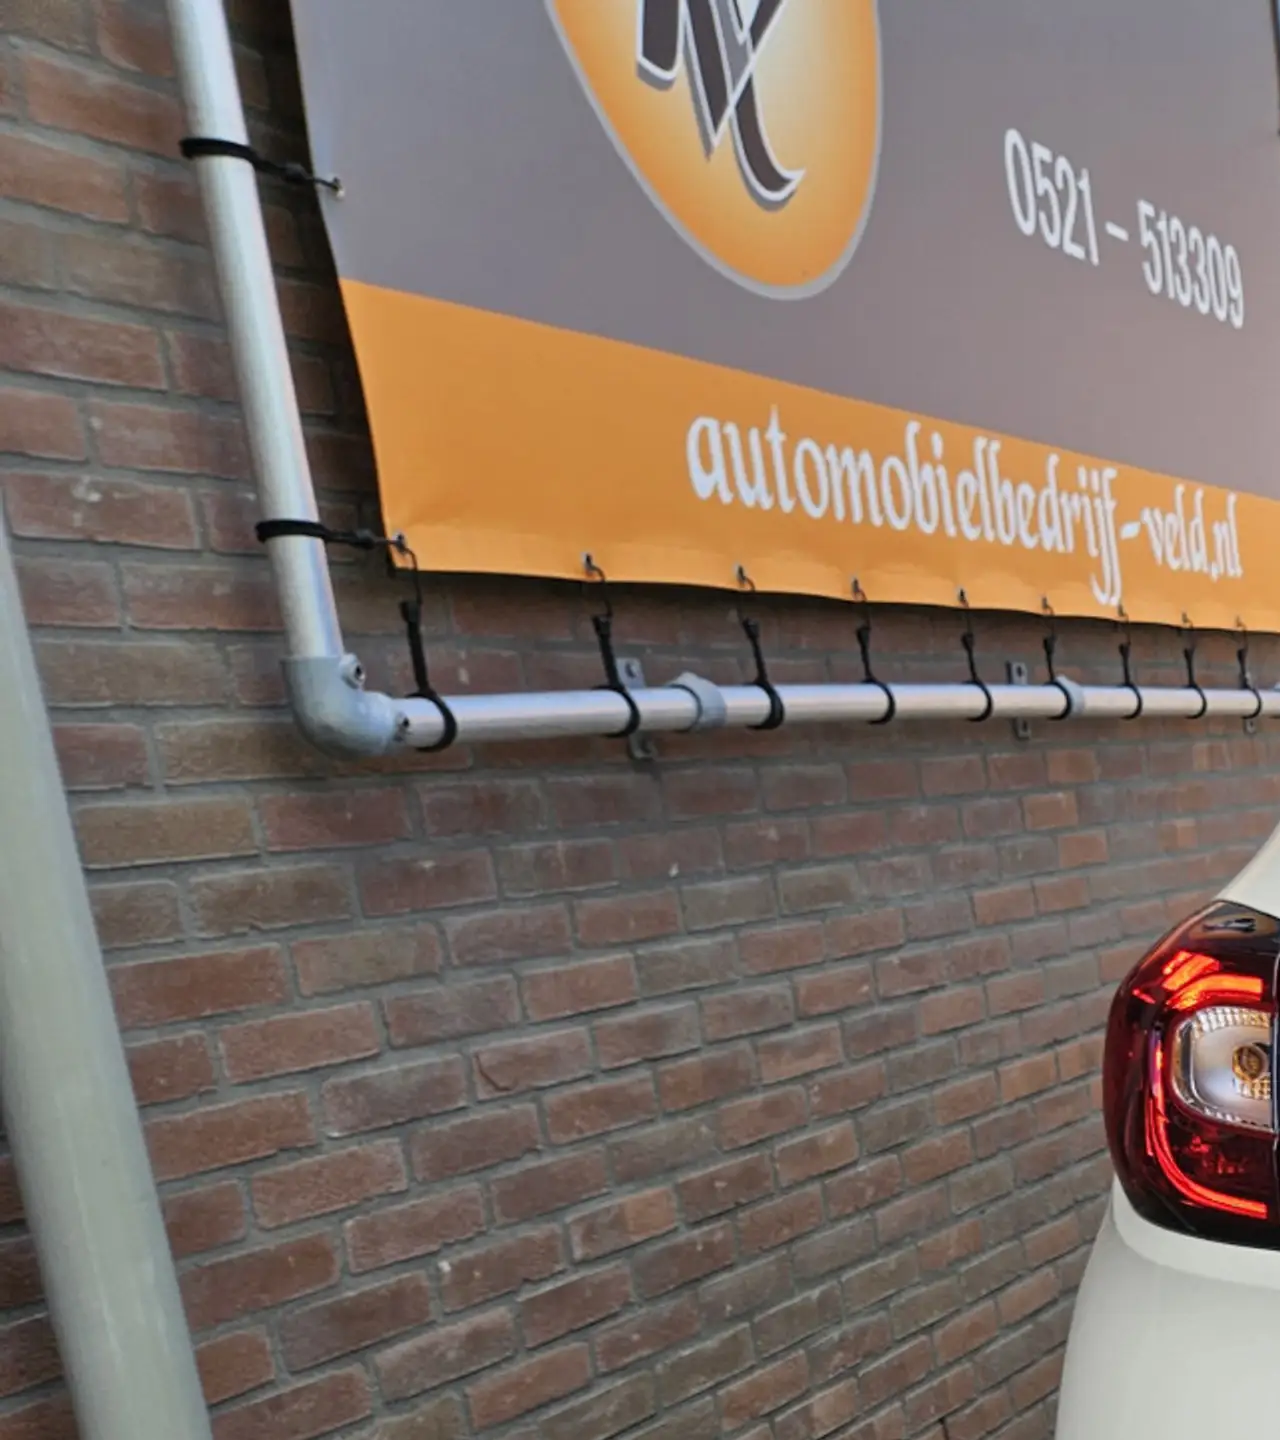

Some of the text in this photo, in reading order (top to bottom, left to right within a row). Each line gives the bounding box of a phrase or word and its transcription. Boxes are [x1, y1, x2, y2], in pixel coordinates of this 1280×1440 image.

[1004, 128, 1099, 266] 0521
[1138, 199, 1244, 329] 513309
[685, 404, 1243, 606] automobielbedrijf-veld.nl
